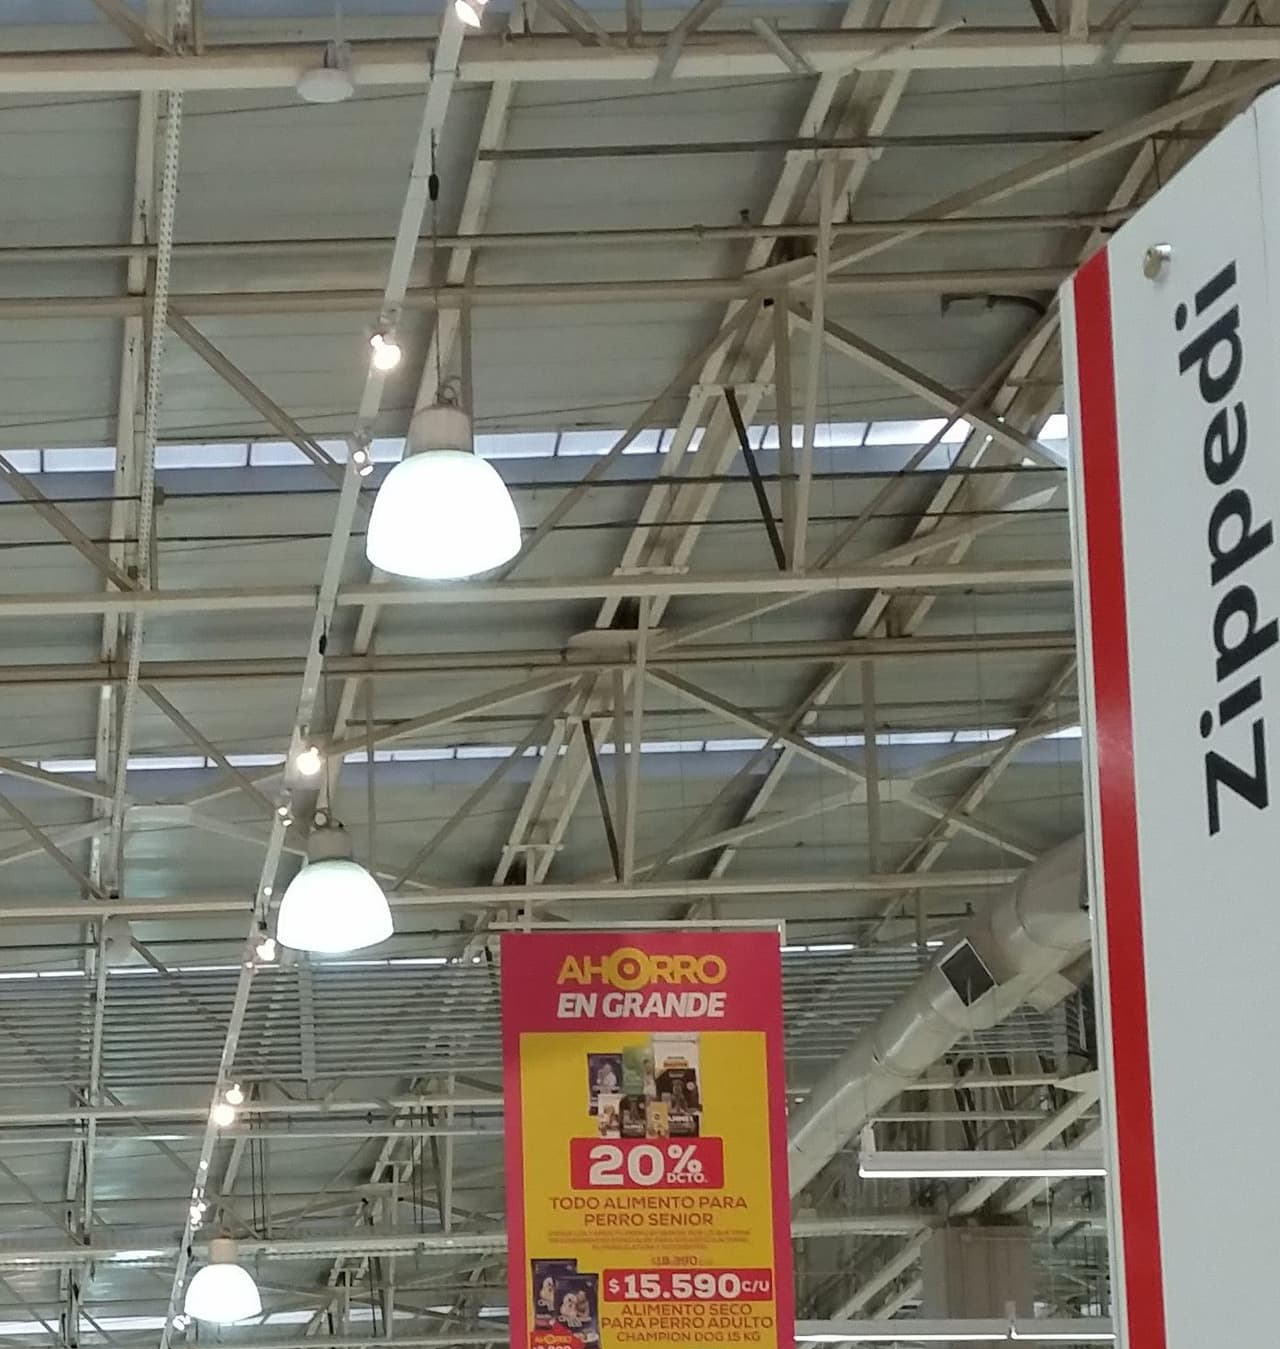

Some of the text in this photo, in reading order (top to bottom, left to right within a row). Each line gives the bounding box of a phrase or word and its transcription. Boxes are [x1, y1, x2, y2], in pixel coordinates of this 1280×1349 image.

[1174, 260, 1280, 837] Zippedi
[557, 946, 728, 991] AHORRO
[557, 992, 727, 1019] EN GRANDE
[550, 1196, 748, 1210] TODO ALIMENTO PARA
[584, 1213, 713, 1226] PERRO SENIOR
[621, 1303, 752, 1316] ALIMENTO SECO
[601, 1317, 773, 1330] PARA PERRO ADULTO
[616, 1331, 690, 1343] CHAMPION
[693, 1331, 724, 1343] DOG
[743, 1331, 761, 1343] KG
